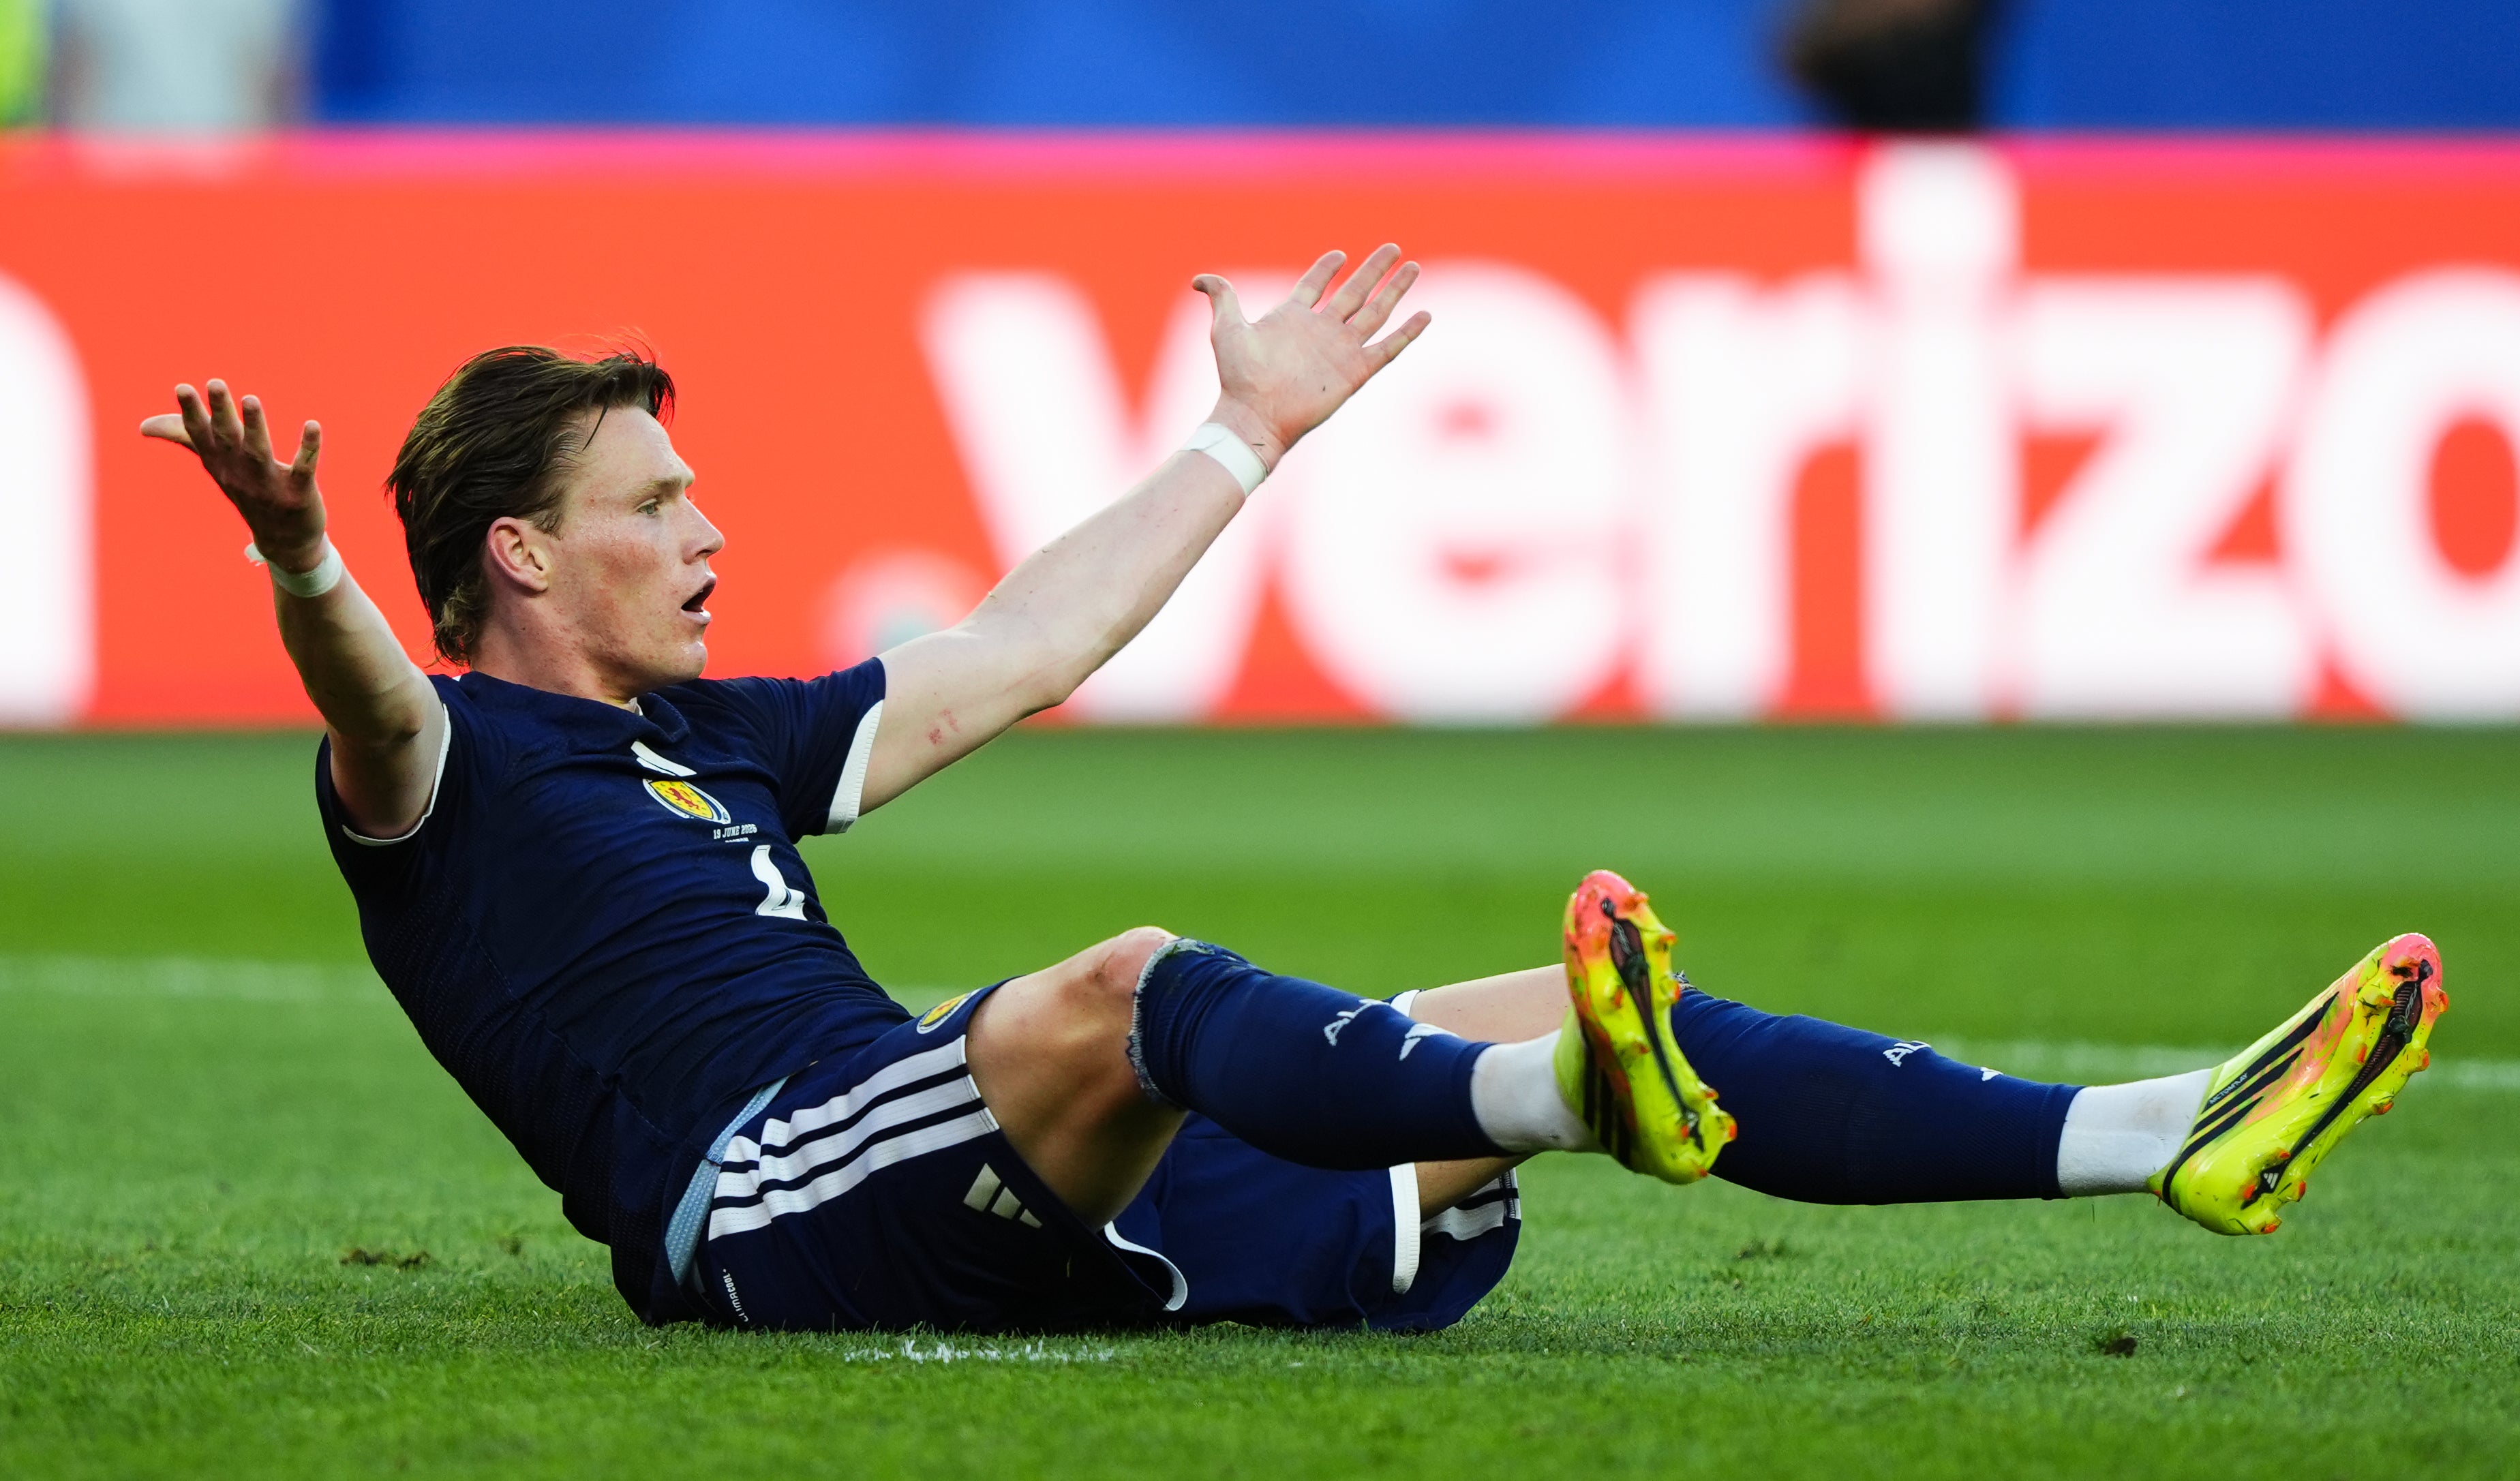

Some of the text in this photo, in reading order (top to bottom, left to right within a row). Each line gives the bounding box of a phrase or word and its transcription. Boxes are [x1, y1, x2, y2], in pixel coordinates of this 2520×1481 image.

[713, 829, 721, 840] 19
[723, 825, 740, 838] JUNE
[750, 844, 808, 921] 4
